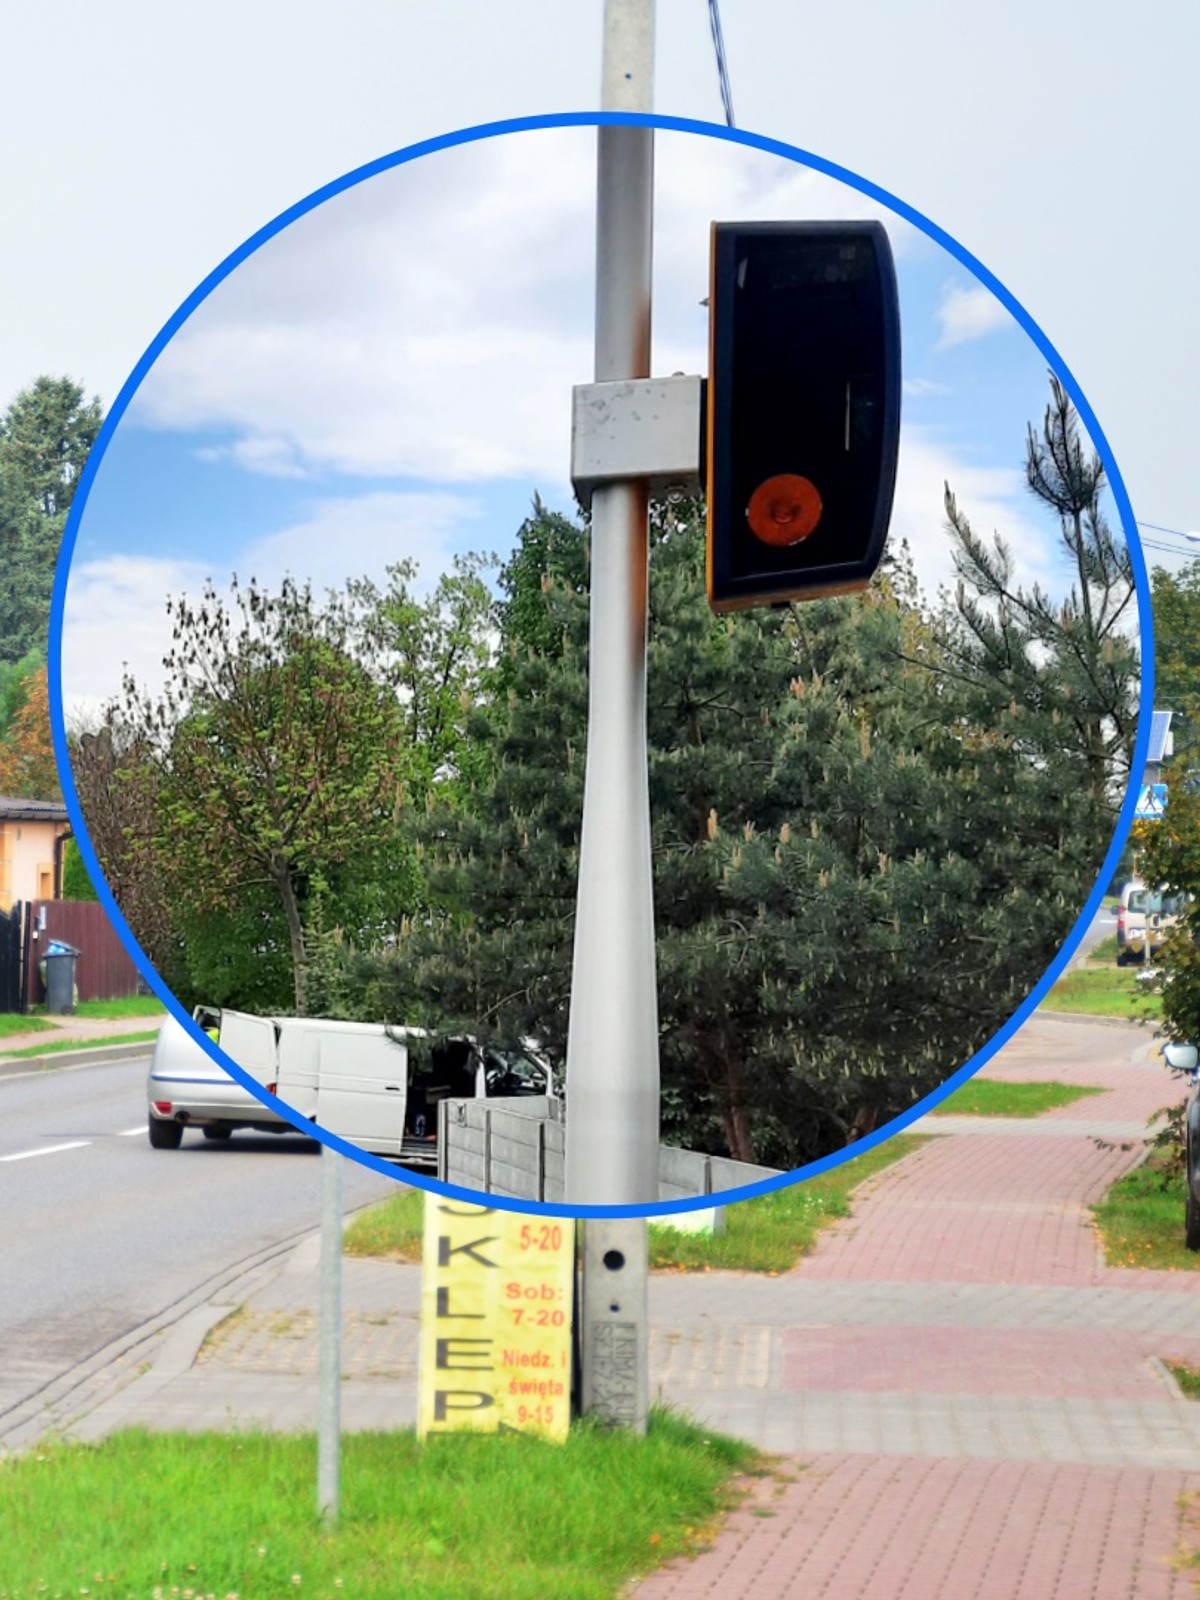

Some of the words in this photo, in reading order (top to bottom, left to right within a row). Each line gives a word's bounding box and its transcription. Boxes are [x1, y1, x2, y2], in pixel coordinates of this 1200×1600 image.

[520, 1225, 562, 1250] 5-20
[434, 1205, 500, 1421] KLEP
[512, 1309, 564, 1327] 7-20
[509, 1377, 563, 1400] święta
[517, 1405, 553, 1424] 9-15
